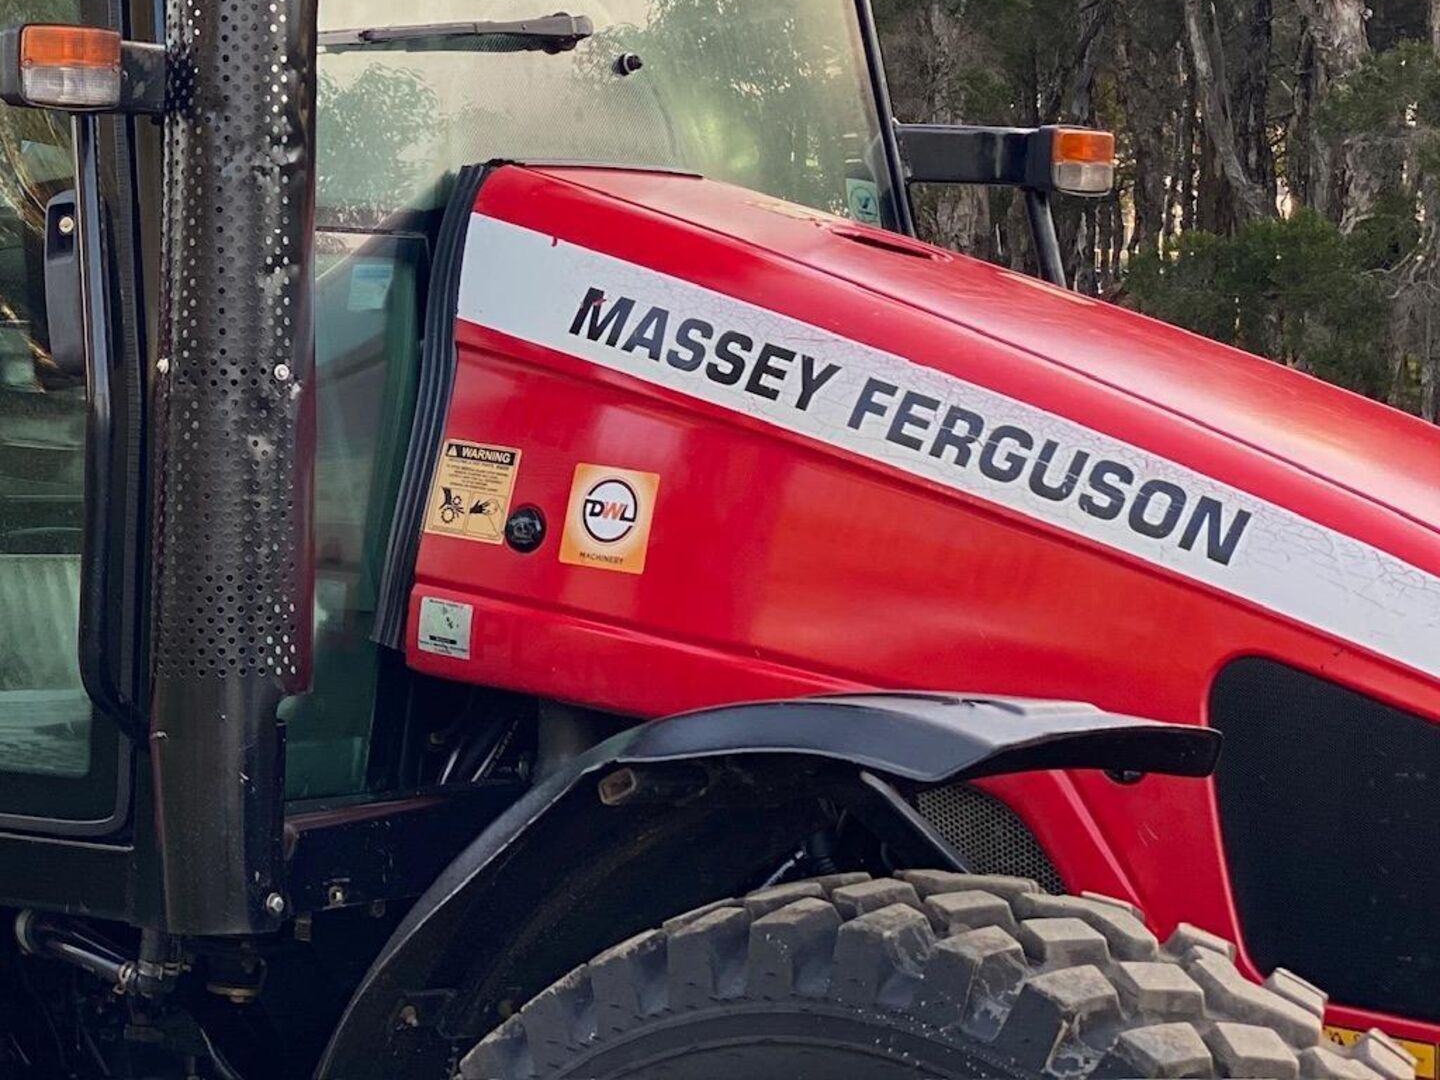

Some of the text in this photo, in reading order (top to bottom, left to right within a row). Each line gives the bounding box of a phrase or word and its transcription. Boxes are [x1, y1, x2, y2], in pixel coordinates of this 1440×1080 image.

[568, 287, 1251, 567] MASSEY FERGUSON
[462, 446, 511, 464] WARNING
[586, 498, 636, 523] DWL
[579, 550, 624, 566] MACHINERY
